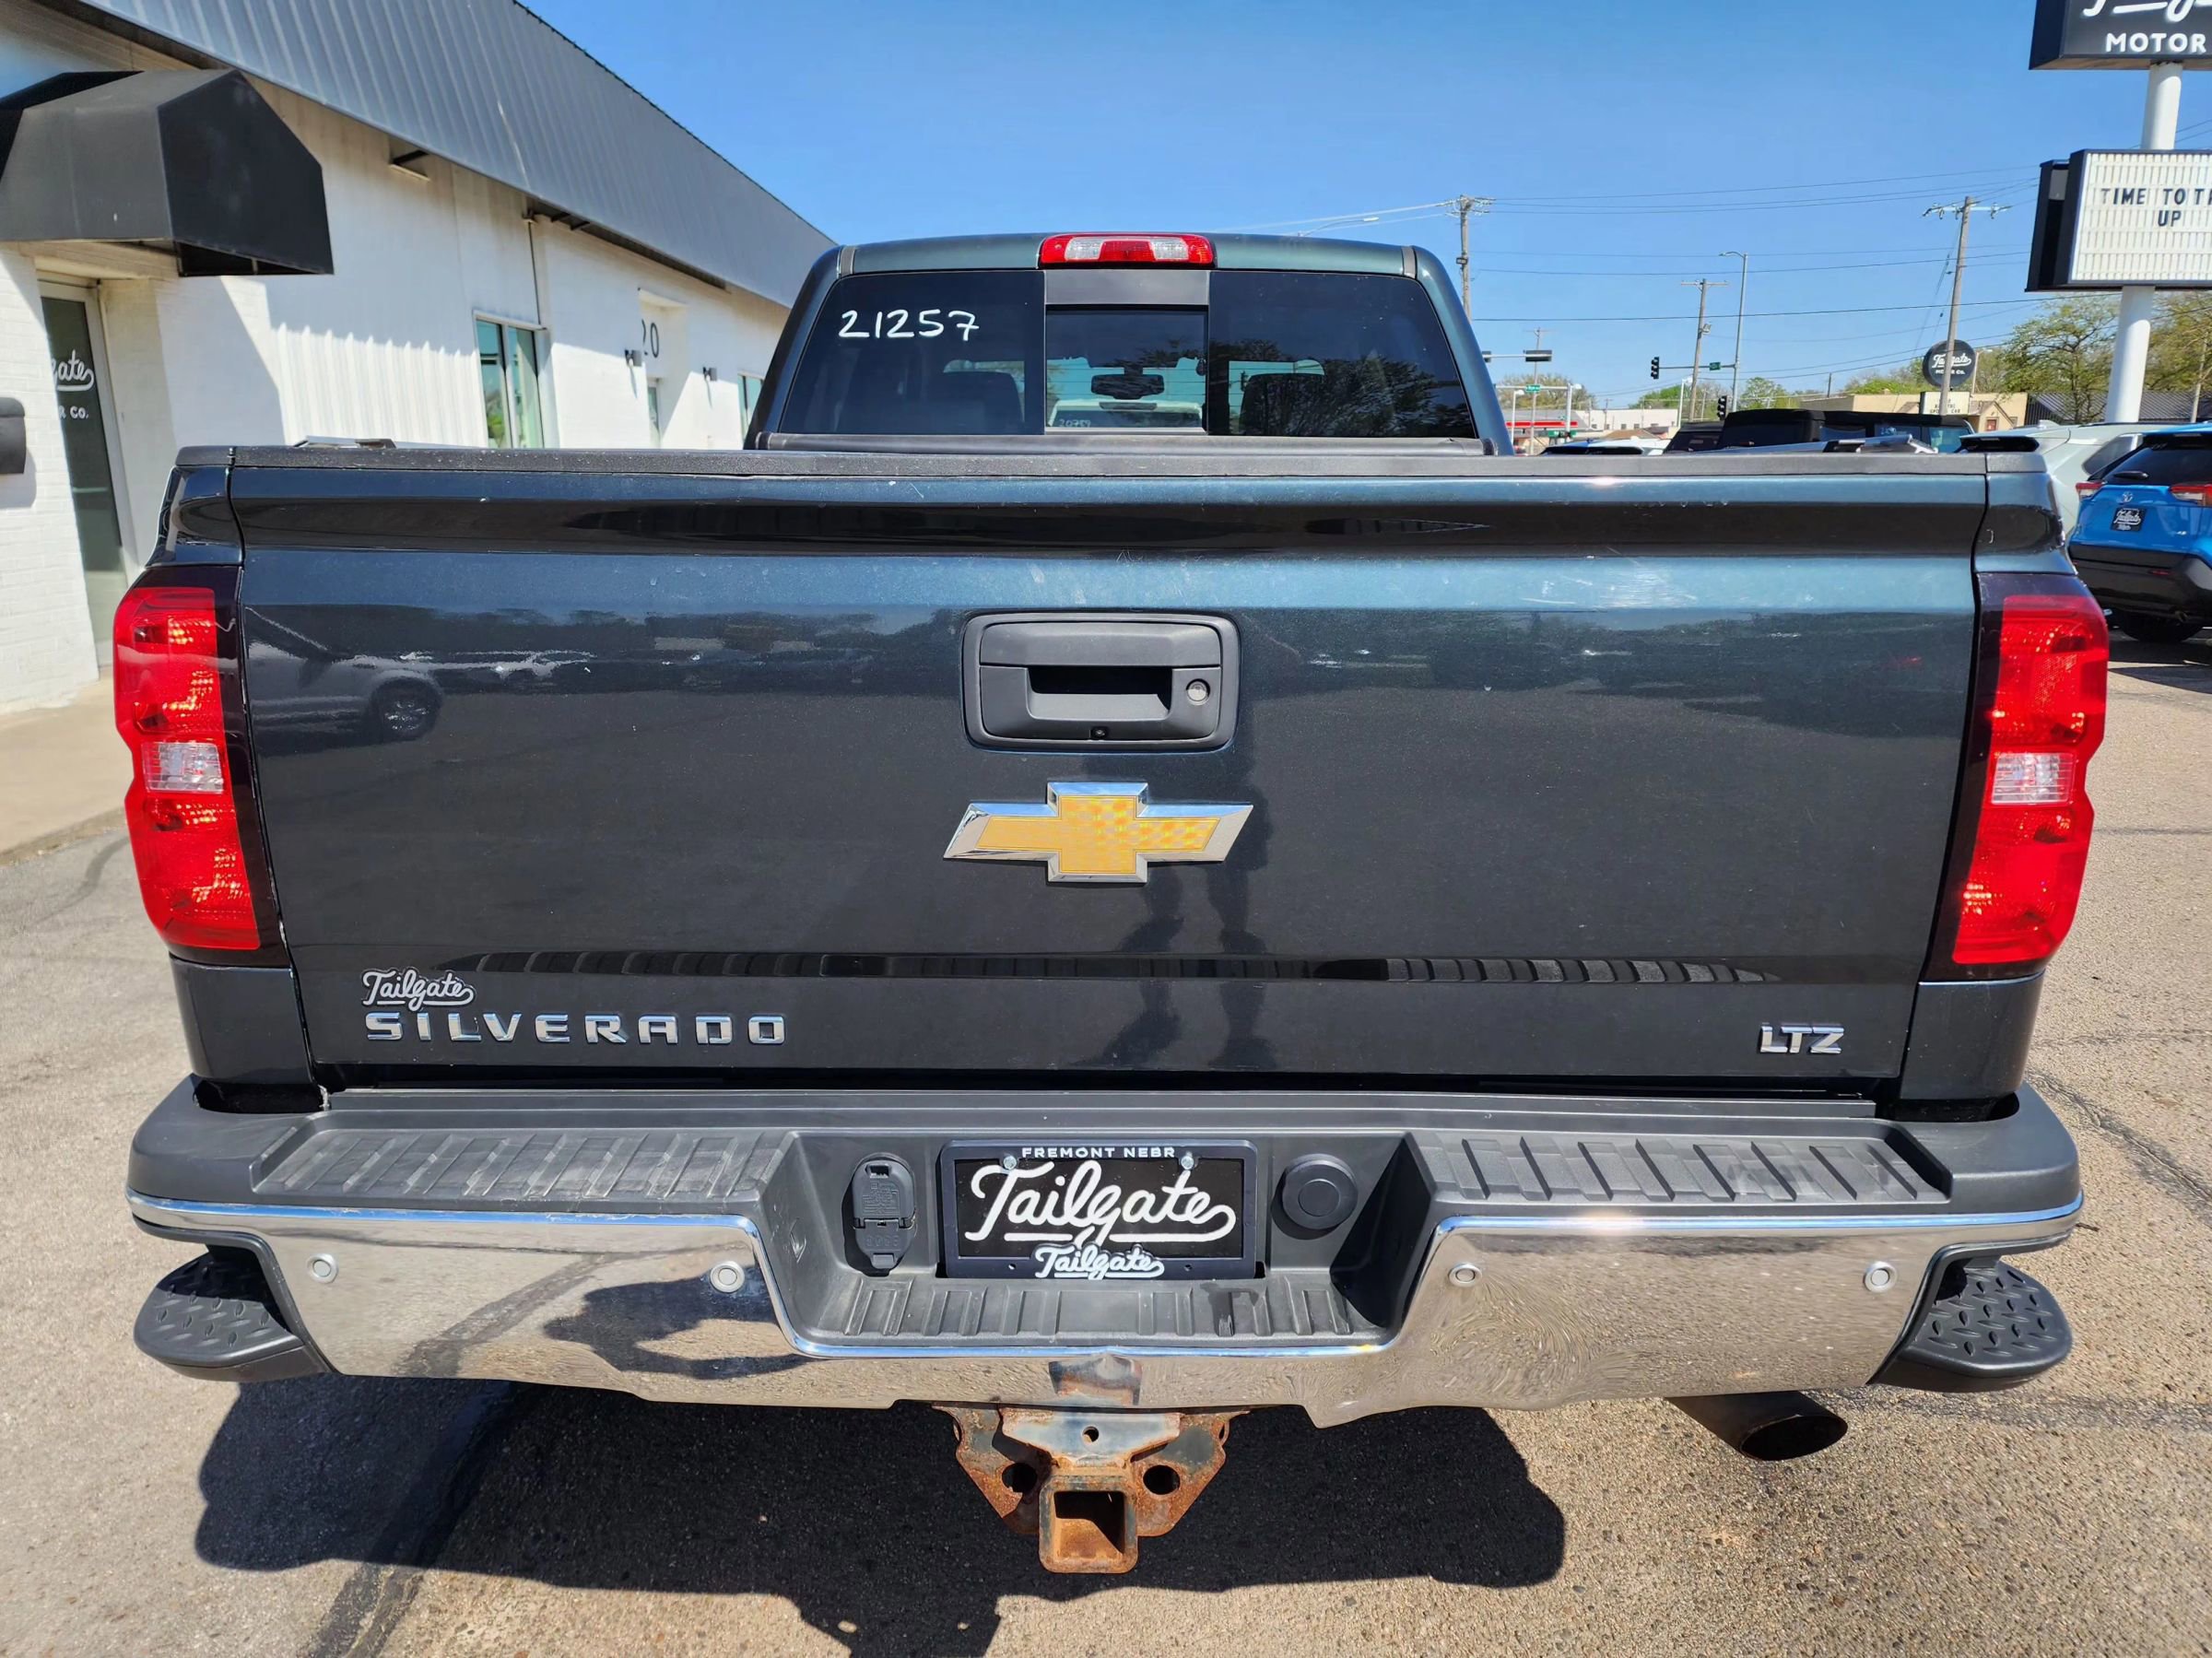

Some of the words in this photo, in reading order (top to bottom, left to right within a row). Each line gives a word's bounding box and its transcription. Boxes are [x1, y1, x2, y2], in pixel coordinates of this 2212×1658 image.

[2105, 32, 2206, 53] MOTOR
[2100, 188, 2147, 205] TIME
[2163, 188, 2186, 205] TO
[2194, 188, 2212, 205] T
[2158, 210, 2182, 227] UP
[838, 309, 980, 341] 21257
[360, 970, 475, 1011] Tailgate
[365, 1011, 785, 1045] SILVERADO
[1759, 1025, 1844, 1053] LTZ
[1021, 1146, 1115, 1158] FREMONT
[1124, 1146, 1176, 1158] NEBR
[964, 1160, 1237, 1246] Tailgate
[1034, 1245, 1165, 1280] Tailgate
